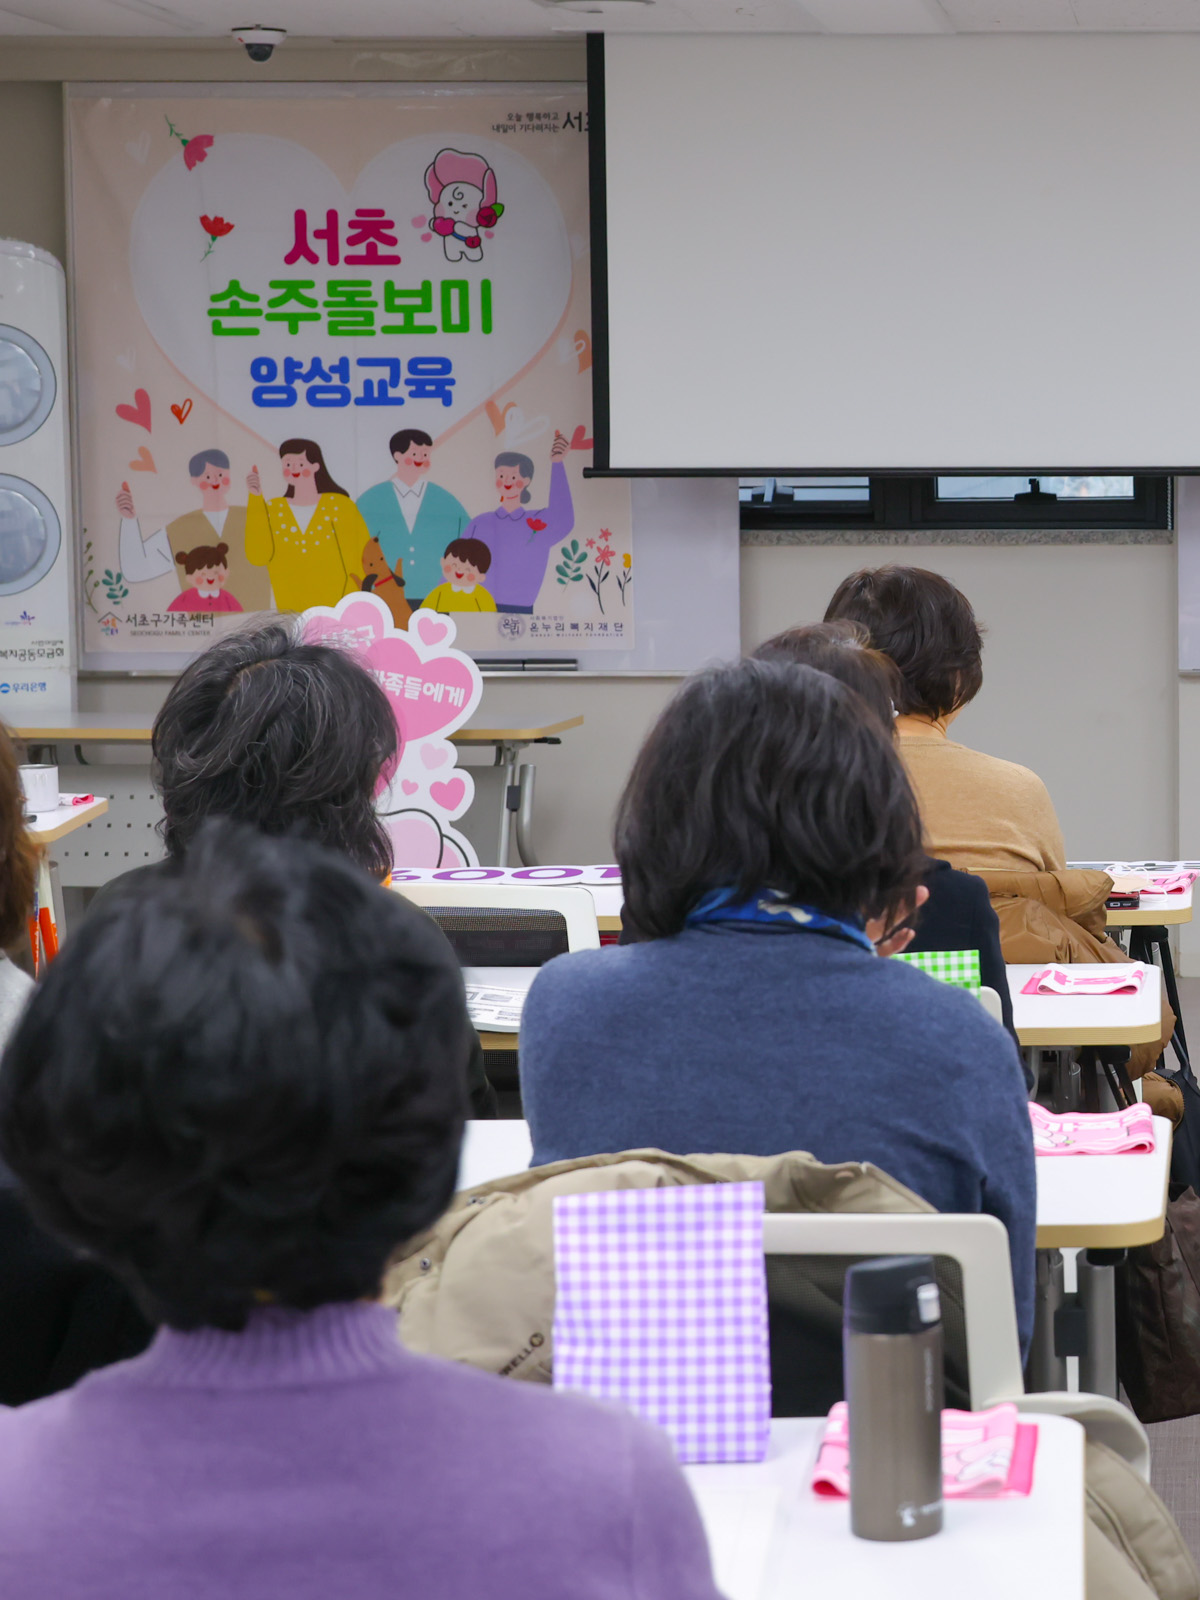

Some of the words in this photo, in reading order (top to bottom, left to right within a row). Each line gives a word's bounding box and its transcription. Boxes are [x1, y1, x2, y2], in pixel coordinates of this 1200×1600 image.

[284, 208, 402, 266] 서초
[207, 279, 493, 336] 손주돌보미
[250, 356, 456, 408] 양성교육
[126, 612, 214, 628] 서초구가족센터
